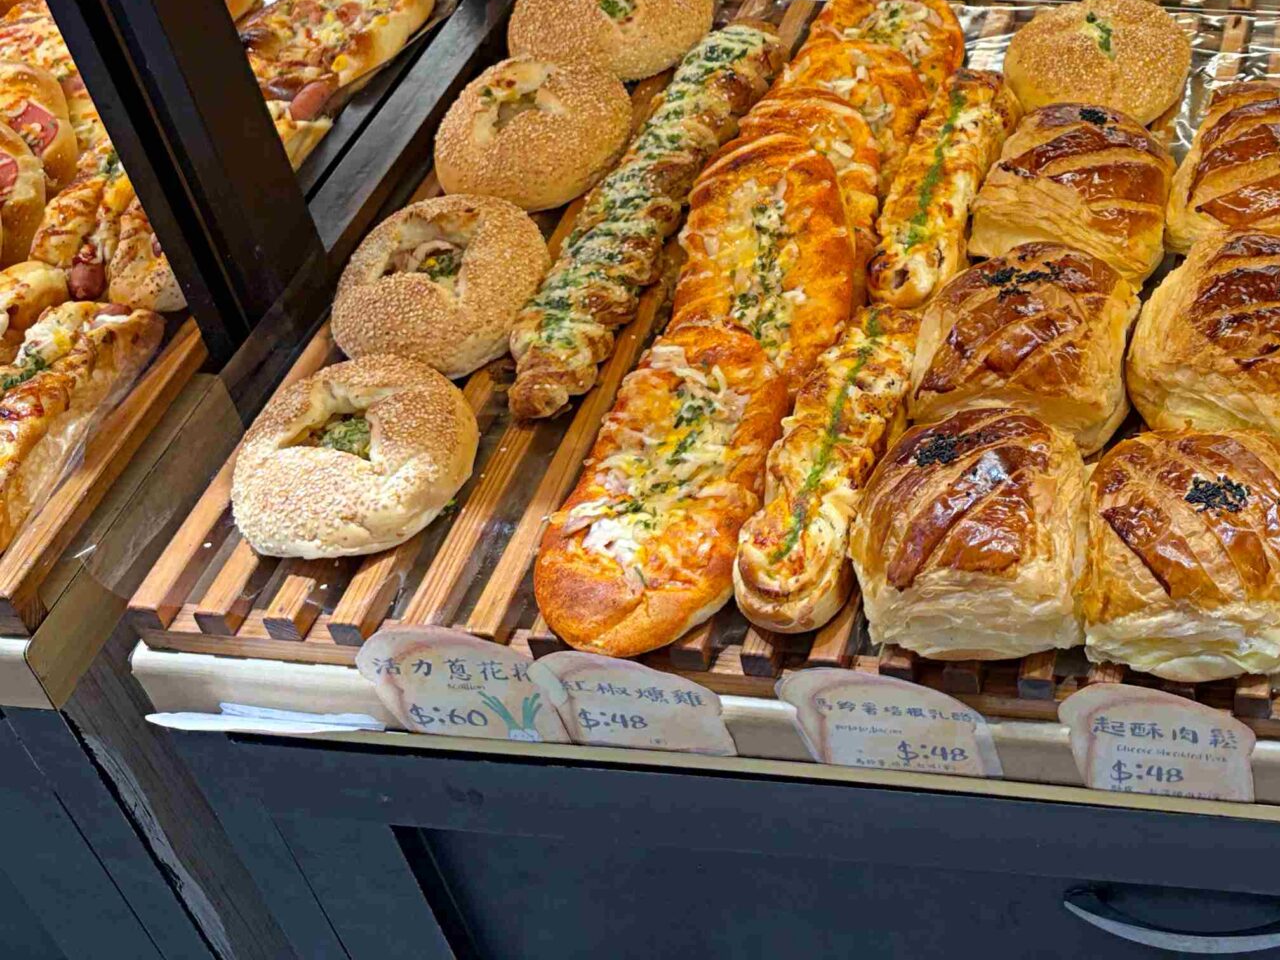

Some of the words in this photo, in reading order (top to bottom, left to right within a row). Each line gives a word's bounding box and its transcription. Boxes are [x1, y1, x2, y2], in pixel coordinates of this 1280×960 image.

[409, 704, 488, 727] $:60
[578, 708, 648, 730] $:48
[1093, 716, 1238, 749] 起酥肉鬆
[897, 741, 969, 765] $:48
[1110, 760, 1184, 783] $:48
